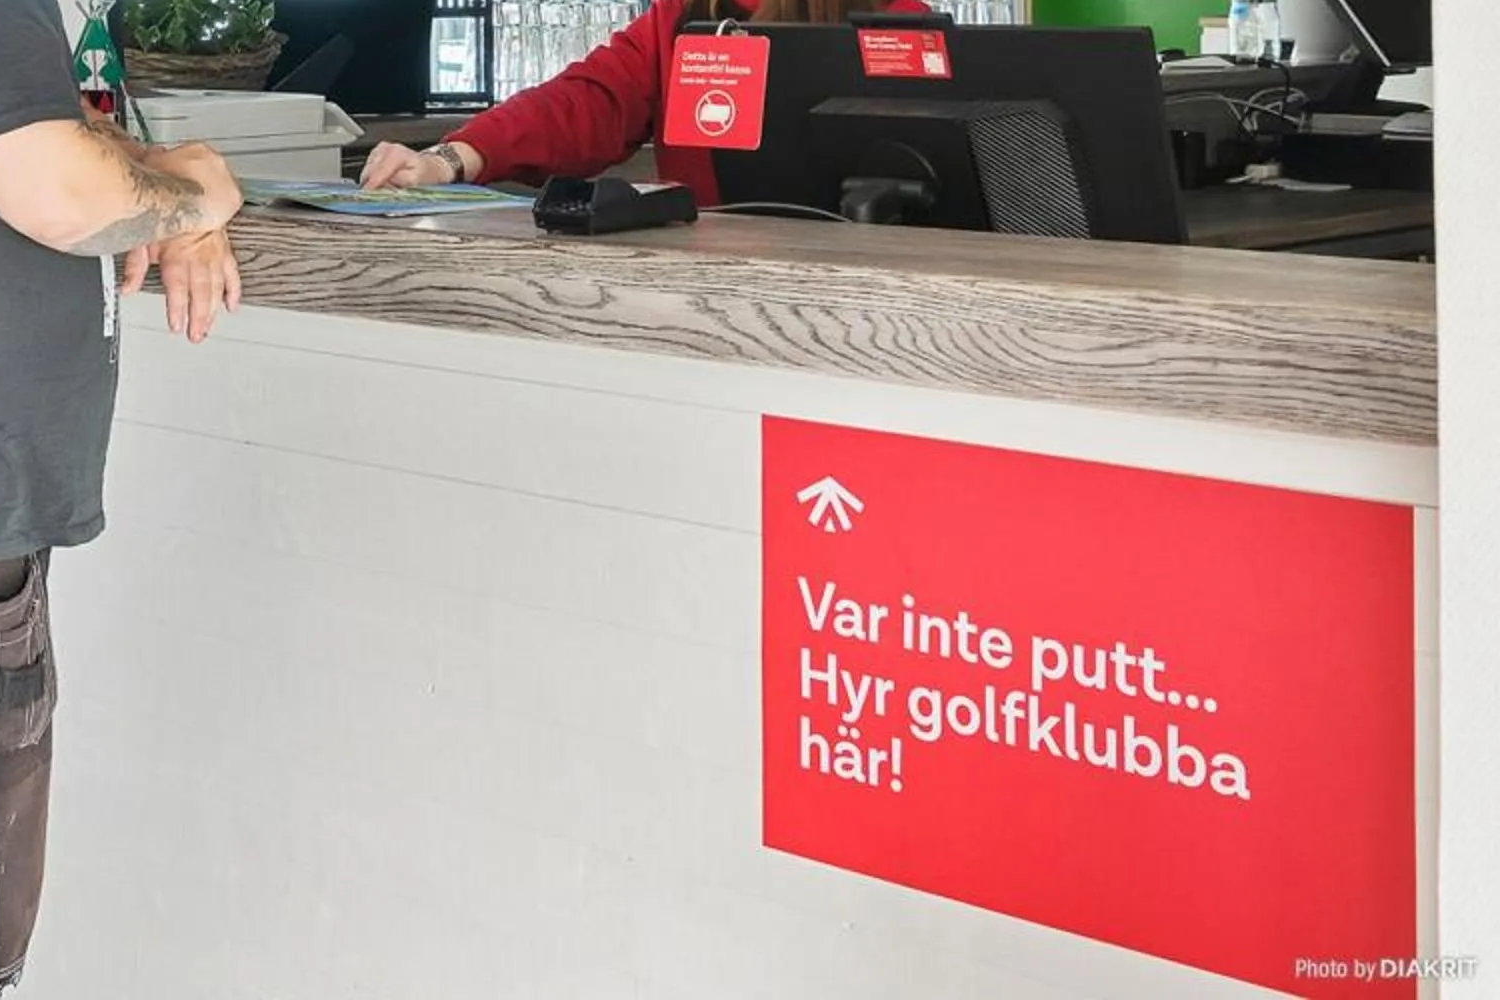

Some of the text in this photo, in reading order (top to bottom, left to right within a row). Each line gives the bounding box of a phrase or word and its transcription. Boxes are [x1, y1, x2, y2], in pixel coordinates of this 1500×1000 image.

[798, 576, 1218, 714] Var inte putt...
[800, 647, 1251, 800] Hyr golfklubba
[800, 715, 903, 793] här!
